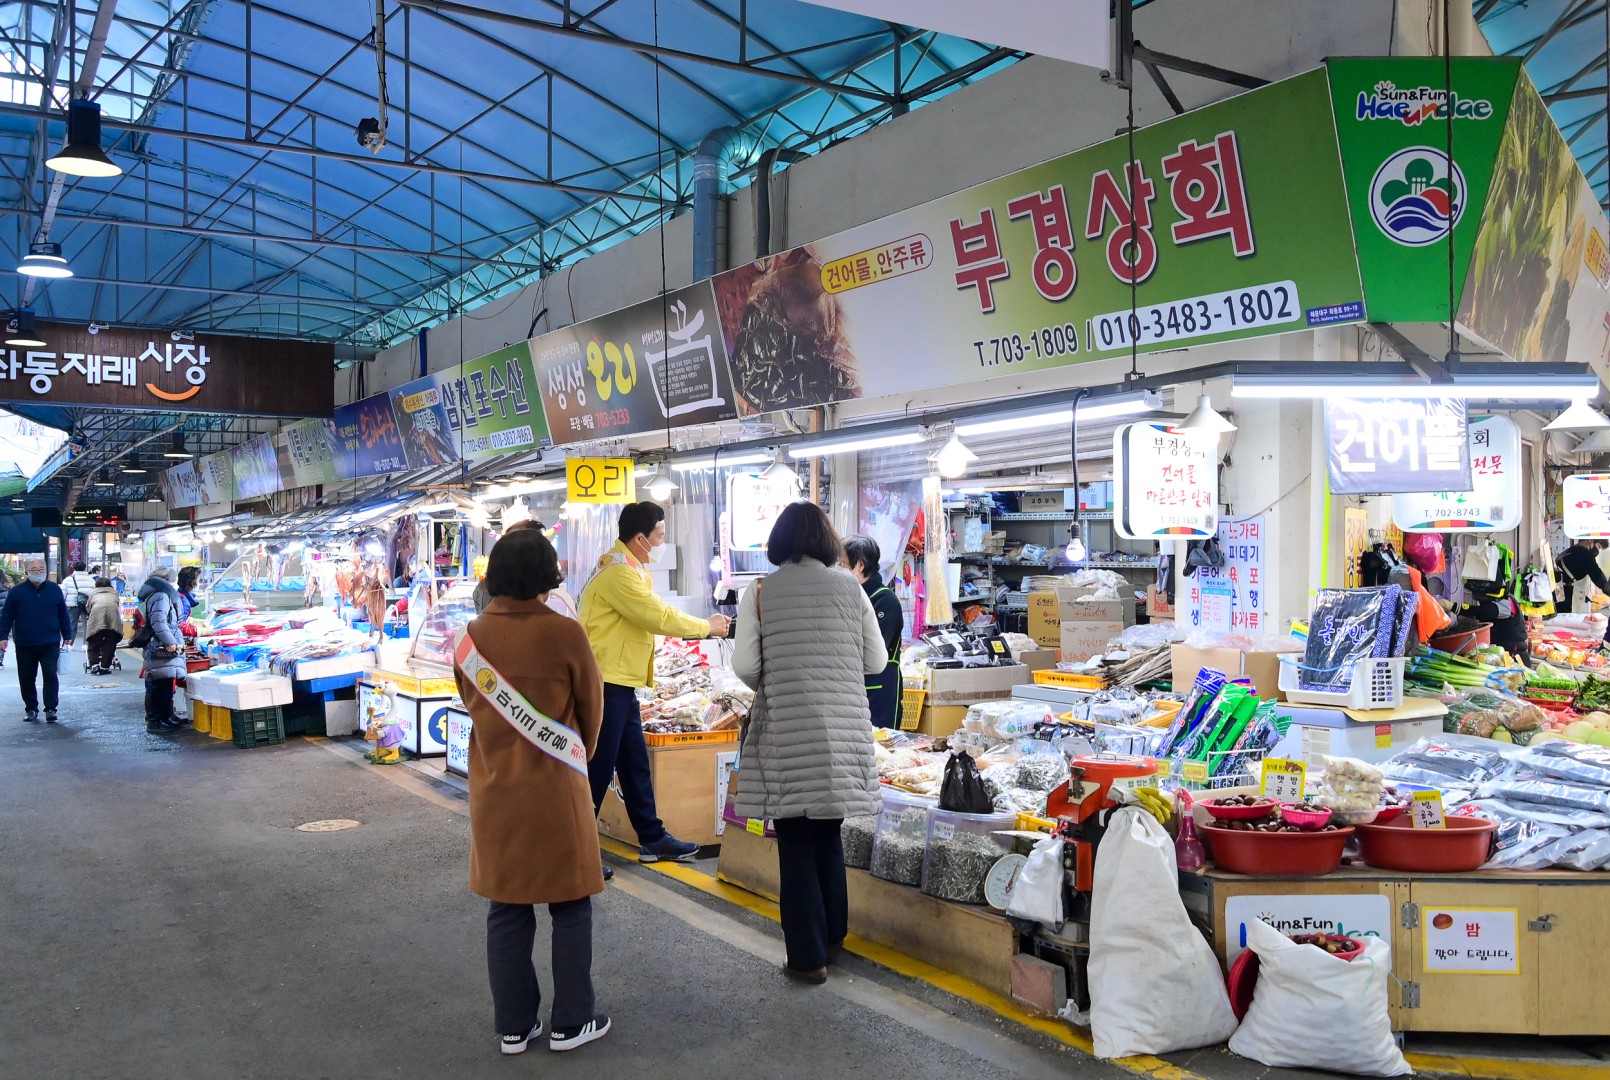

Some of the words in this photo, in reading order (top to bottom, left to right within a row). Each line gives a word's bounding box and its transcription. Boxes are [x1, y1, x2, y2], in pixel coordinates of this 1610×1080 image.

[1358, 93, 1492, 125] Haeundae
[1379, 87, 1449, 101] Sun&Fun
[950, 130, 1254, 313] 부경상회
[974, 324, 1078, 367] T.703-1809
[1100, 286, 1293, 346] 010-3483-1802
[441, 358, 530, 431] 삼천포수산
[1335, 414, 1463, 473] 건어물
[575, 464, 628, 498] 오리
[1229, 545, 1259, 562] 피데기
[495, 689, 537, 731] 마스크
[537, 726, 568, 751] 착용
[1465, 922, 1480, 938] 밤
[1433, 948, 1459, 961] 깎아
[1466, 948, 1513, 962] 드립니다.
